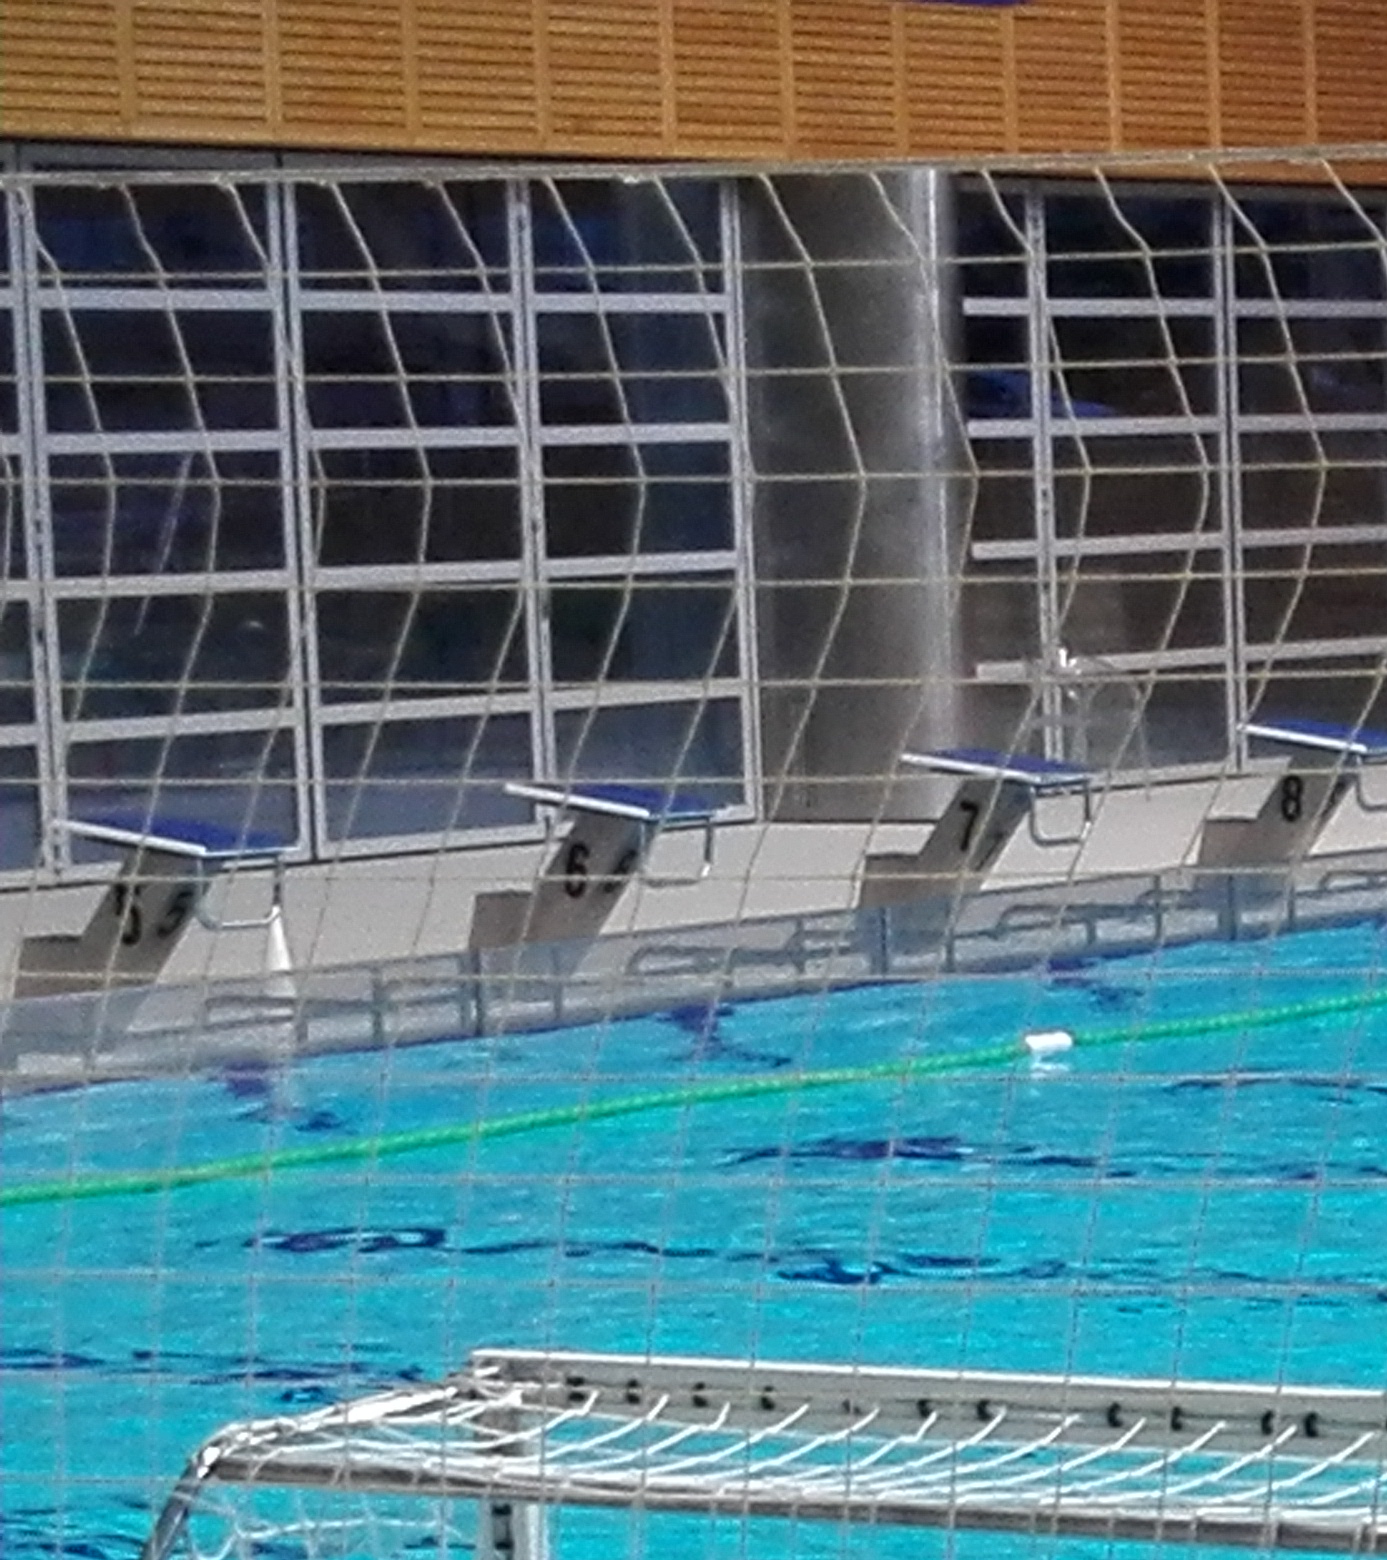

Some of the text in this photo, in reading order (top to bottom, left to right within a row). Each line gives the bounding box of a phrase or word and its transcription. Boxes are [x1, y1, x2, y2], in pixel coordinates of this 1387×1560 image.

[1281, 774, 1303, 822] 8
[960, 800, 980, 853] 7
[564, 842, 590, 898] 6
